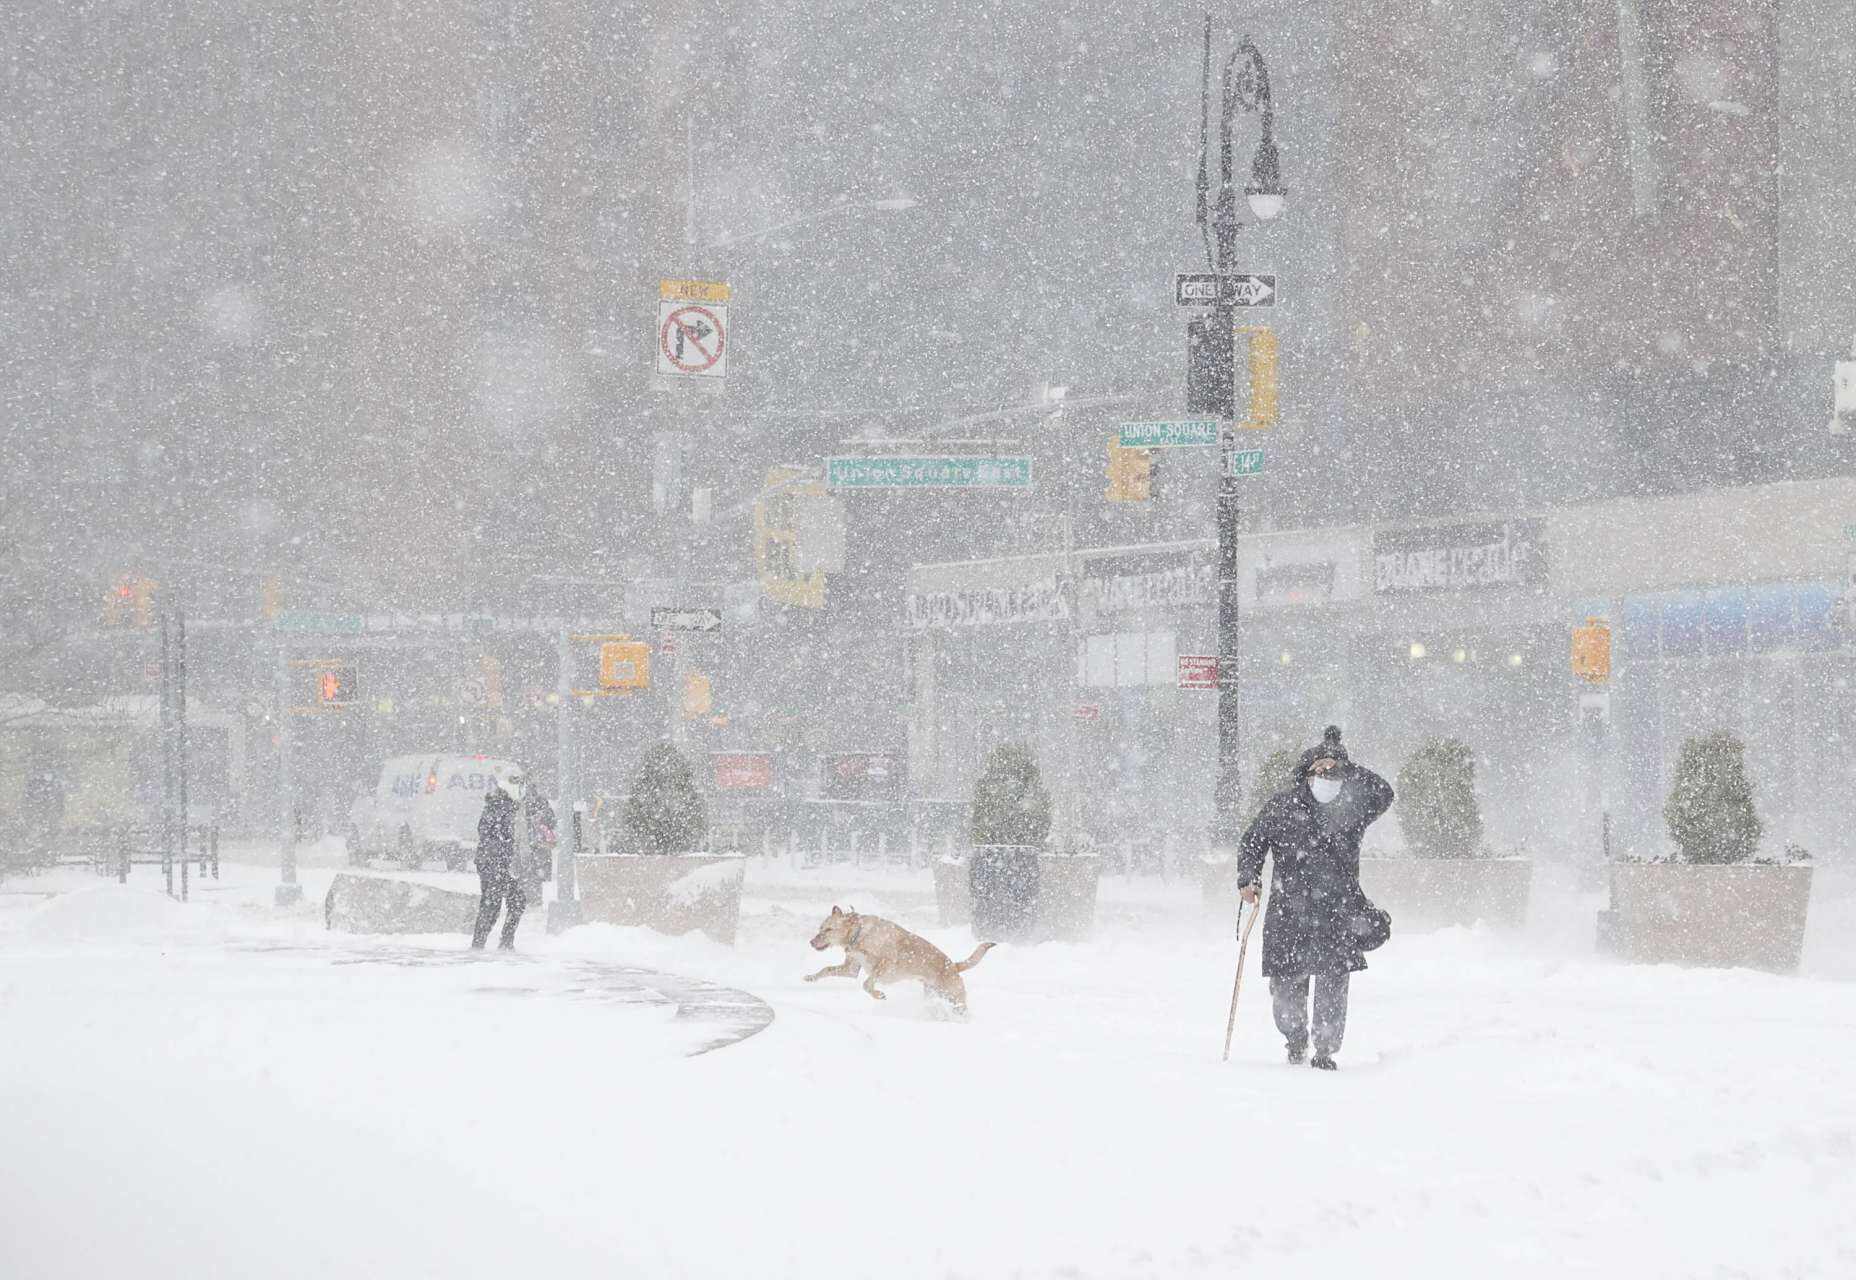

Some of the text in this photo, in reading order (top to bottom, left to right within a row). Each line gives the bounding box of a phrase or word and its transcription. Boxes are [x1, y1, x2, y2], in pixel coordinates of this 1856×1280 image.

[1184, 284, 1215, 297] ONE
[1124, 421, 1217, 438] UNION SQUARE
[835, 466, 896, 480] Union
[901, 464, 972, 482] Square
